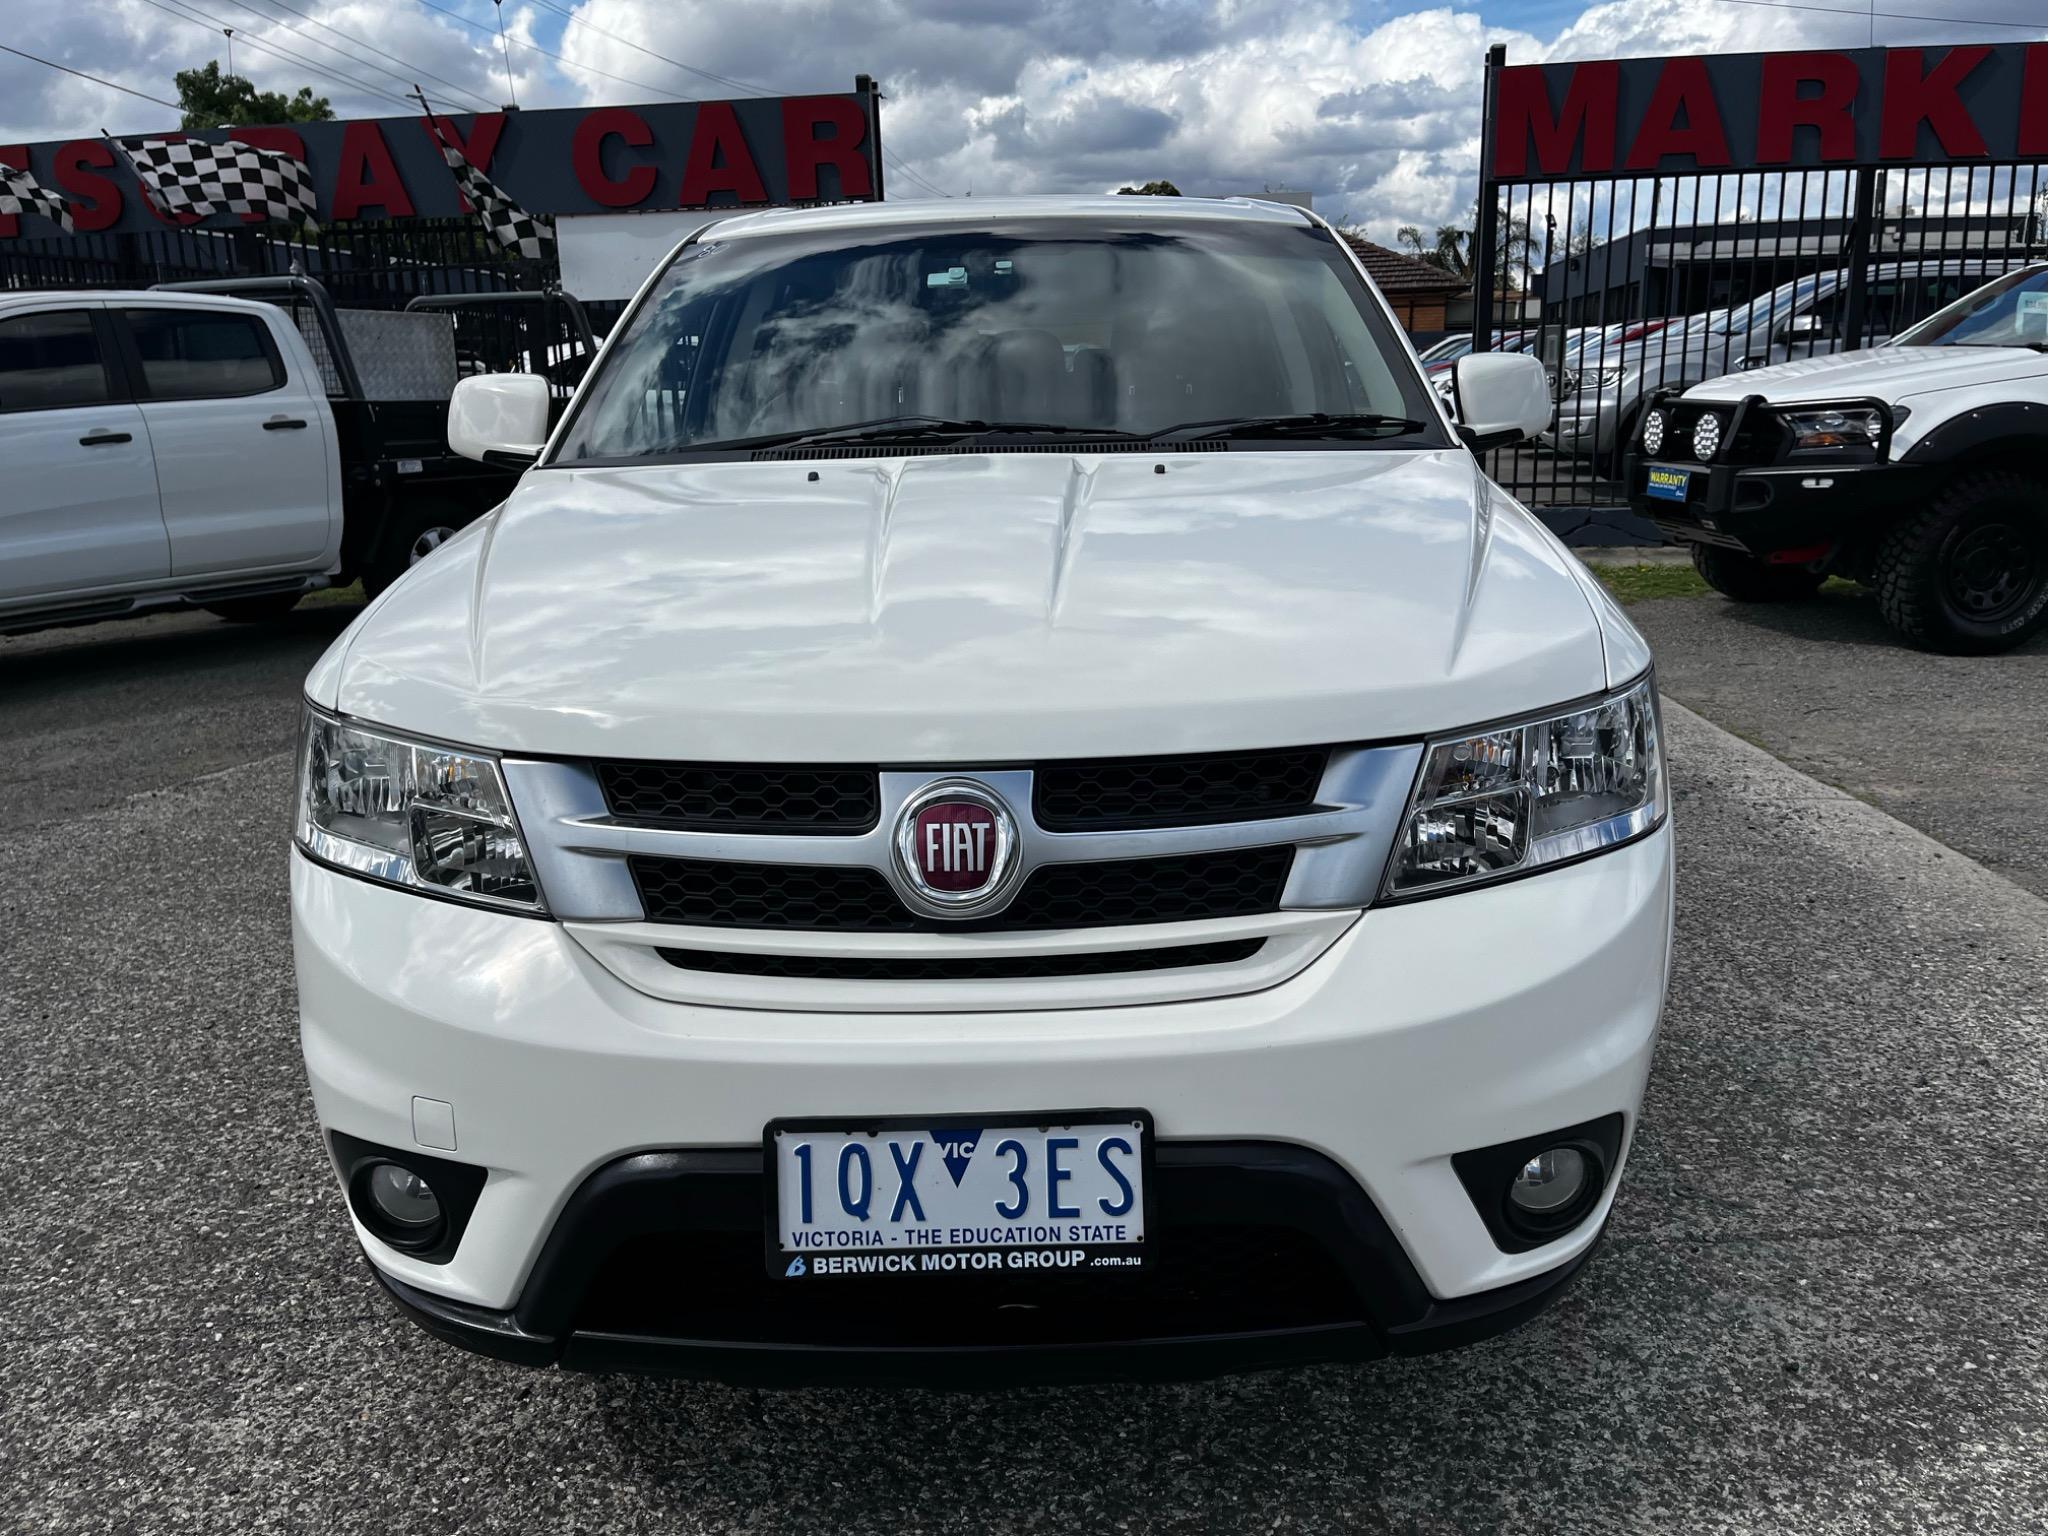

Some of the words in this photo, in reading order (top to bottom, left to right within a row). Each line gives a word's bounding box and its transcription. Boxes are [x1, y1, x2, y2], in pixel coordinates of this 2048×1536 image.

[571, 95, 869, 208] CAR
[1650, 471, 1688, 487] WARRANTY
[925, 822, 991, 872] FIAT
[935, 1141, 975, 1159] VIC
[792, 1141, 927, 1224] 1QX
[993, 1137, 1134, 1220] 3ES
[791, 1230, 883, 1248] VICTORIA
[906, 1228, 942, 1245] THE
[950, 1226, 1065, 1244] EDUCATION
[1069, 1225, 1127, 1242] STATE
[813, 1254, 917, 1275] BERWICK
[921, 1252, 1002, 1271] MOTOR
[1007, 1250, 1086, 1269] GROUP
[1089, 1255, 1142, 1267] .com.au
